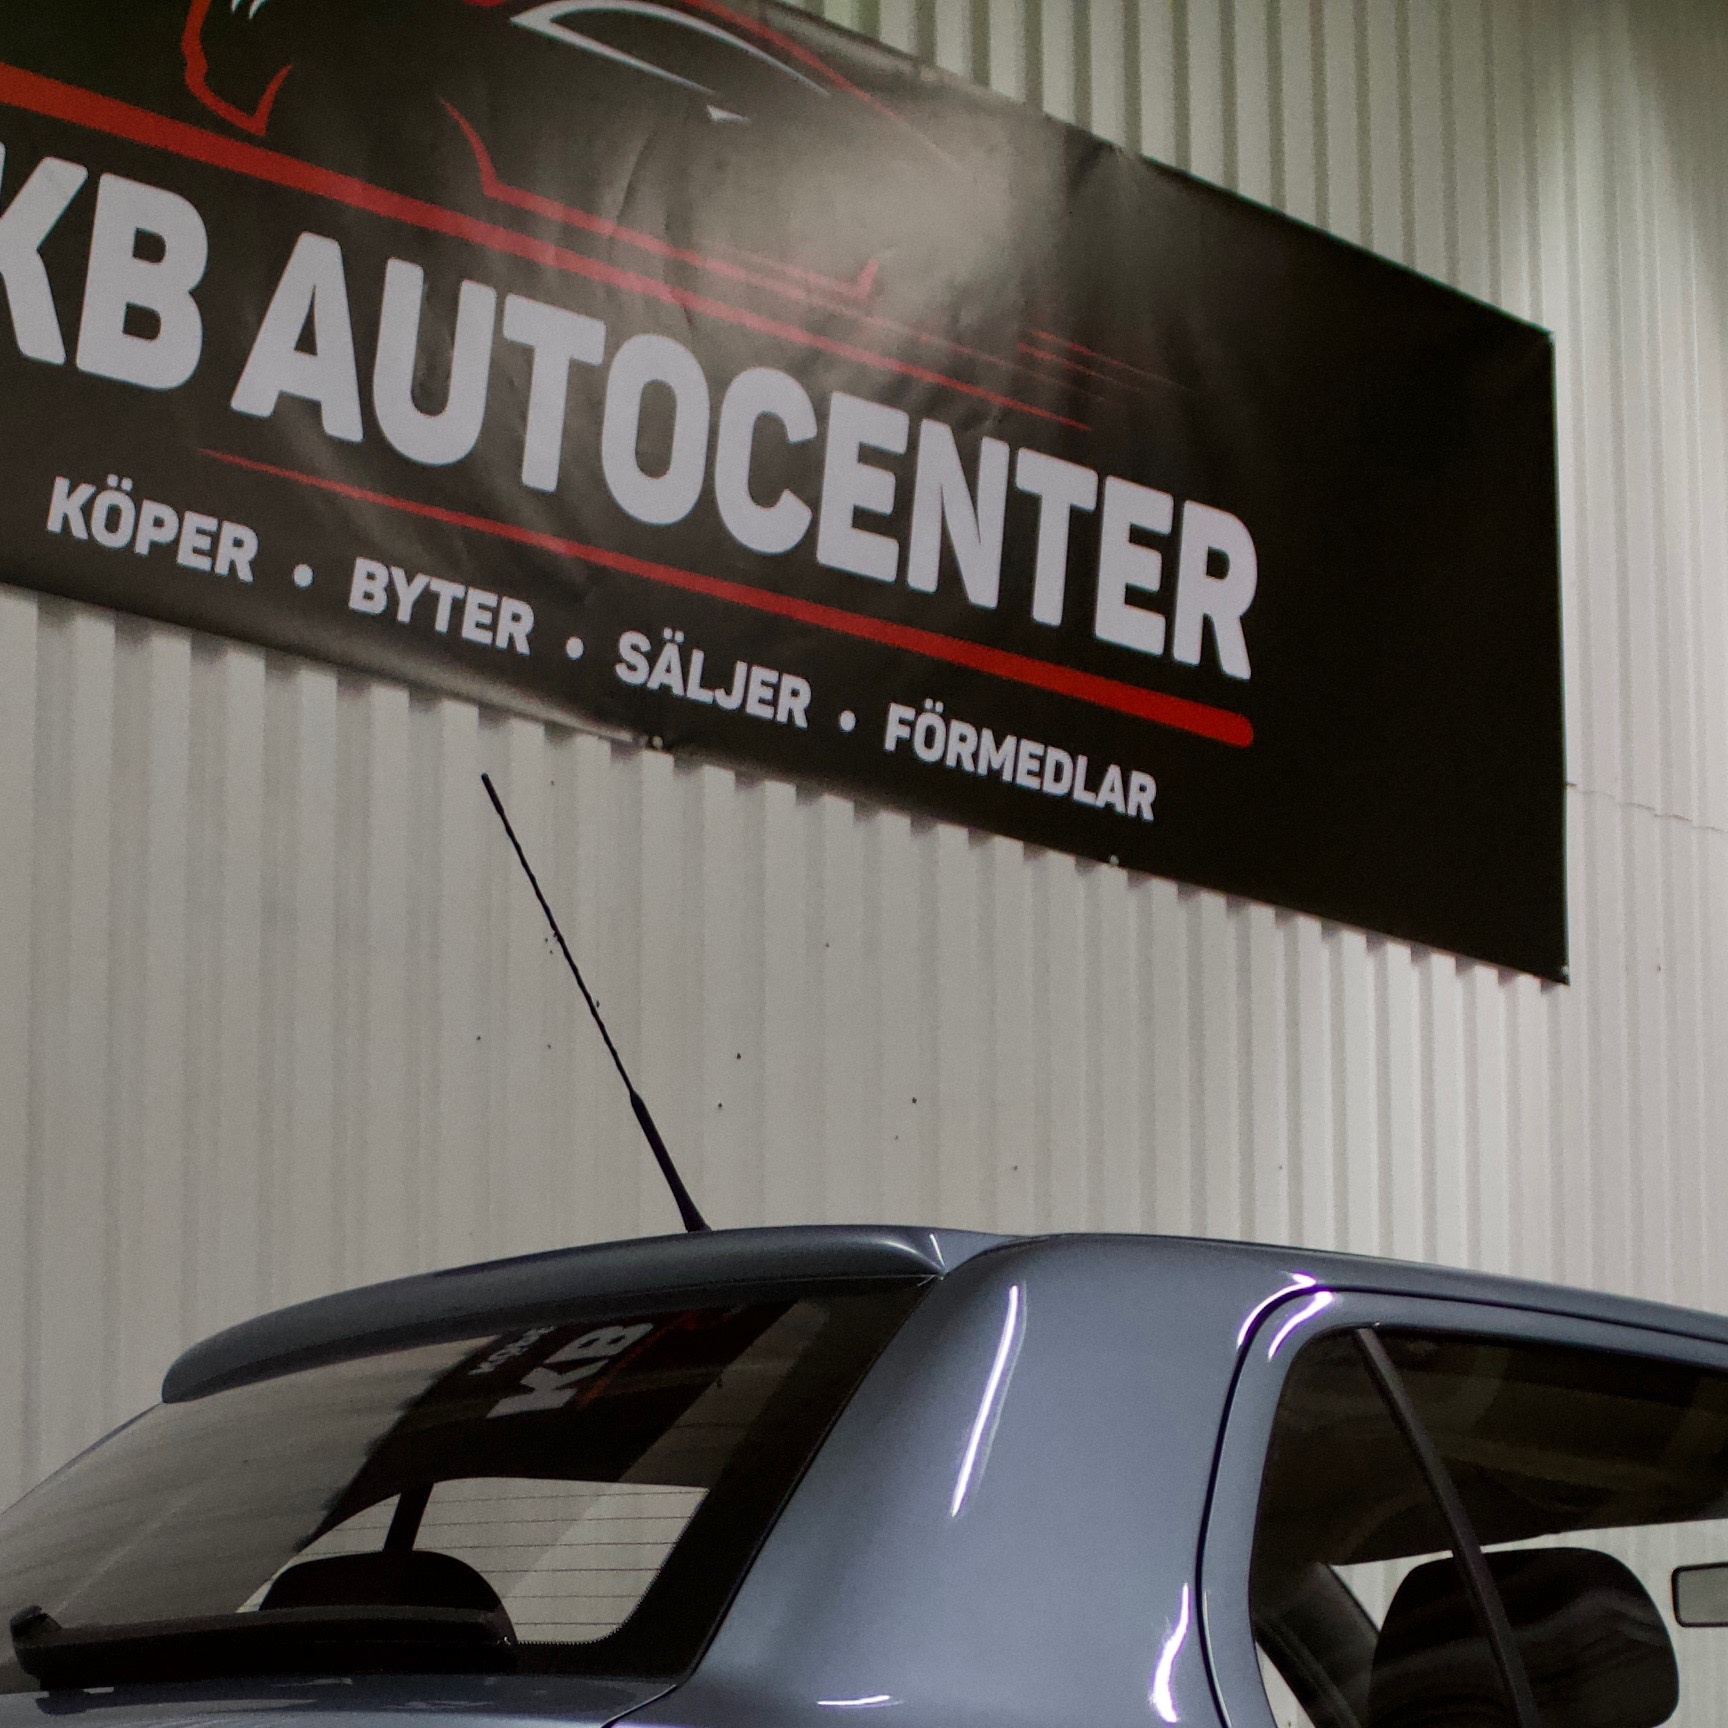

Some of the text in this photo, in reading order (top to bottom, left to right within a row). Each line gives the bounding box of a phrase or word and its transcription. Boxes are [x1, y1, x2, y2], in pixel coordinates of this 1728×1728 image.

[46, 475, 1157, 821] KÖPER BYTER SÄLJER FÖRMEDLAR
[229, 232, 1258, 681] AUTOCENTER
